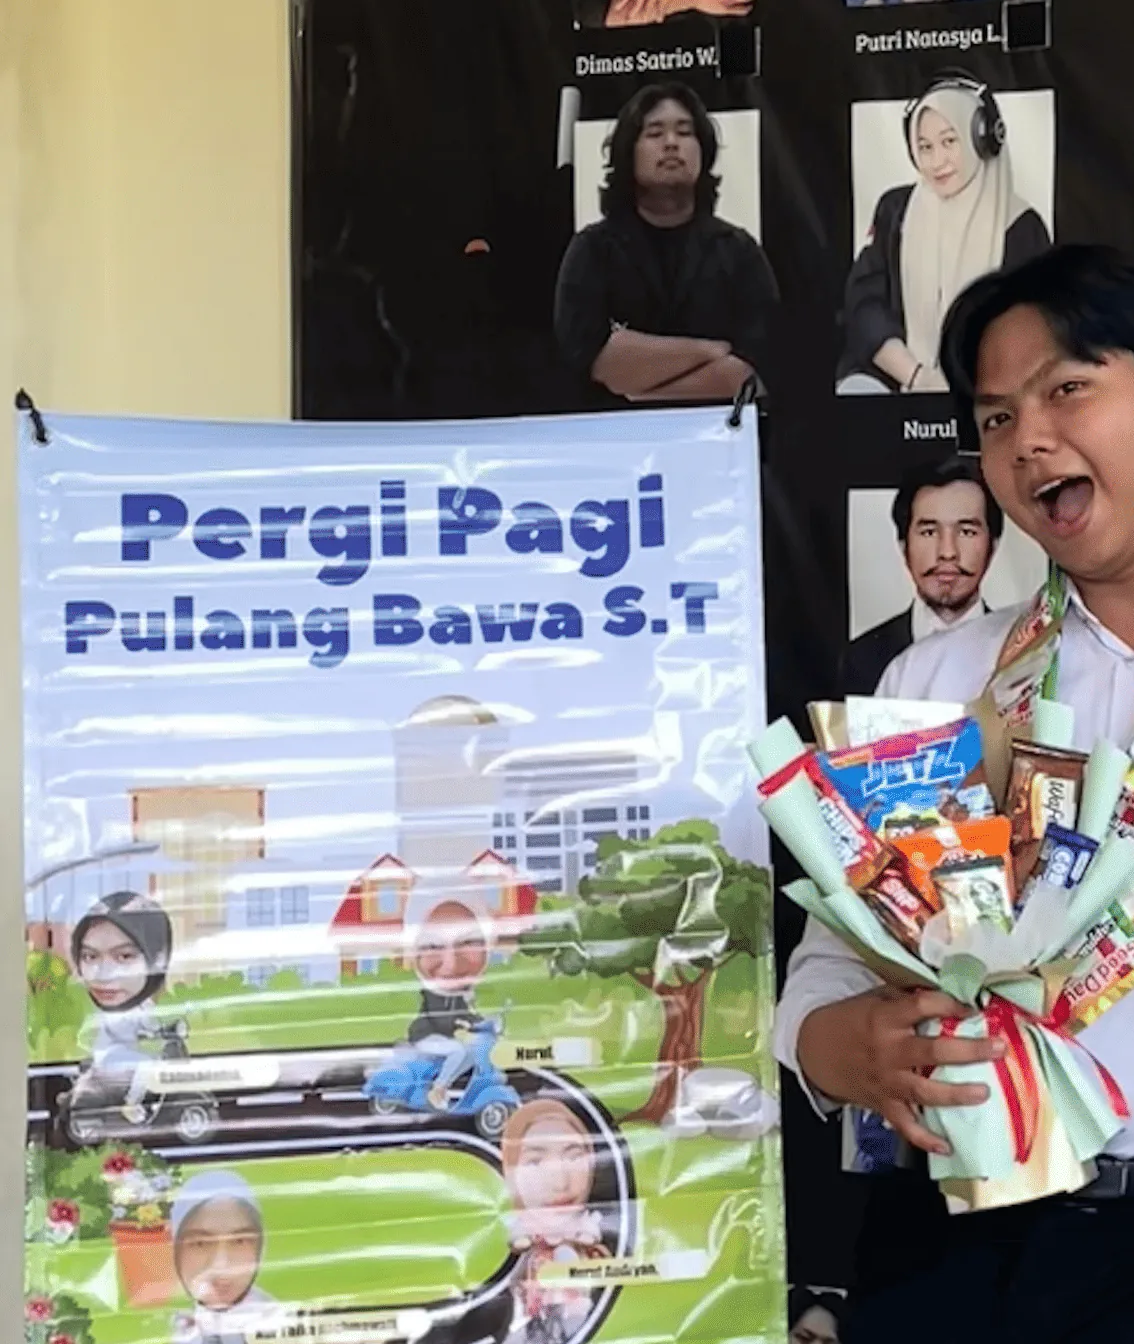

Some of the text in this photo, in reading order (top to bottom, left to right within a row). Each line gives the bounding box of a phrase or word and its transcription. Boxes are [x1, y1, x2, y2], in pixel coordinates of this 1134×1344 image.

[855, 29, 902, 53] Putri
[904, 27, 983, 50] Natasya
[575, 53, 634, 77] Dimas
[635, 46, 694, 72] Satrio
[903, 418, 959, 440] Nurul
[120, 473, 665, 586] Pergi Pagi
[64, 581, 719, 669] Pulang Bawa S.T
